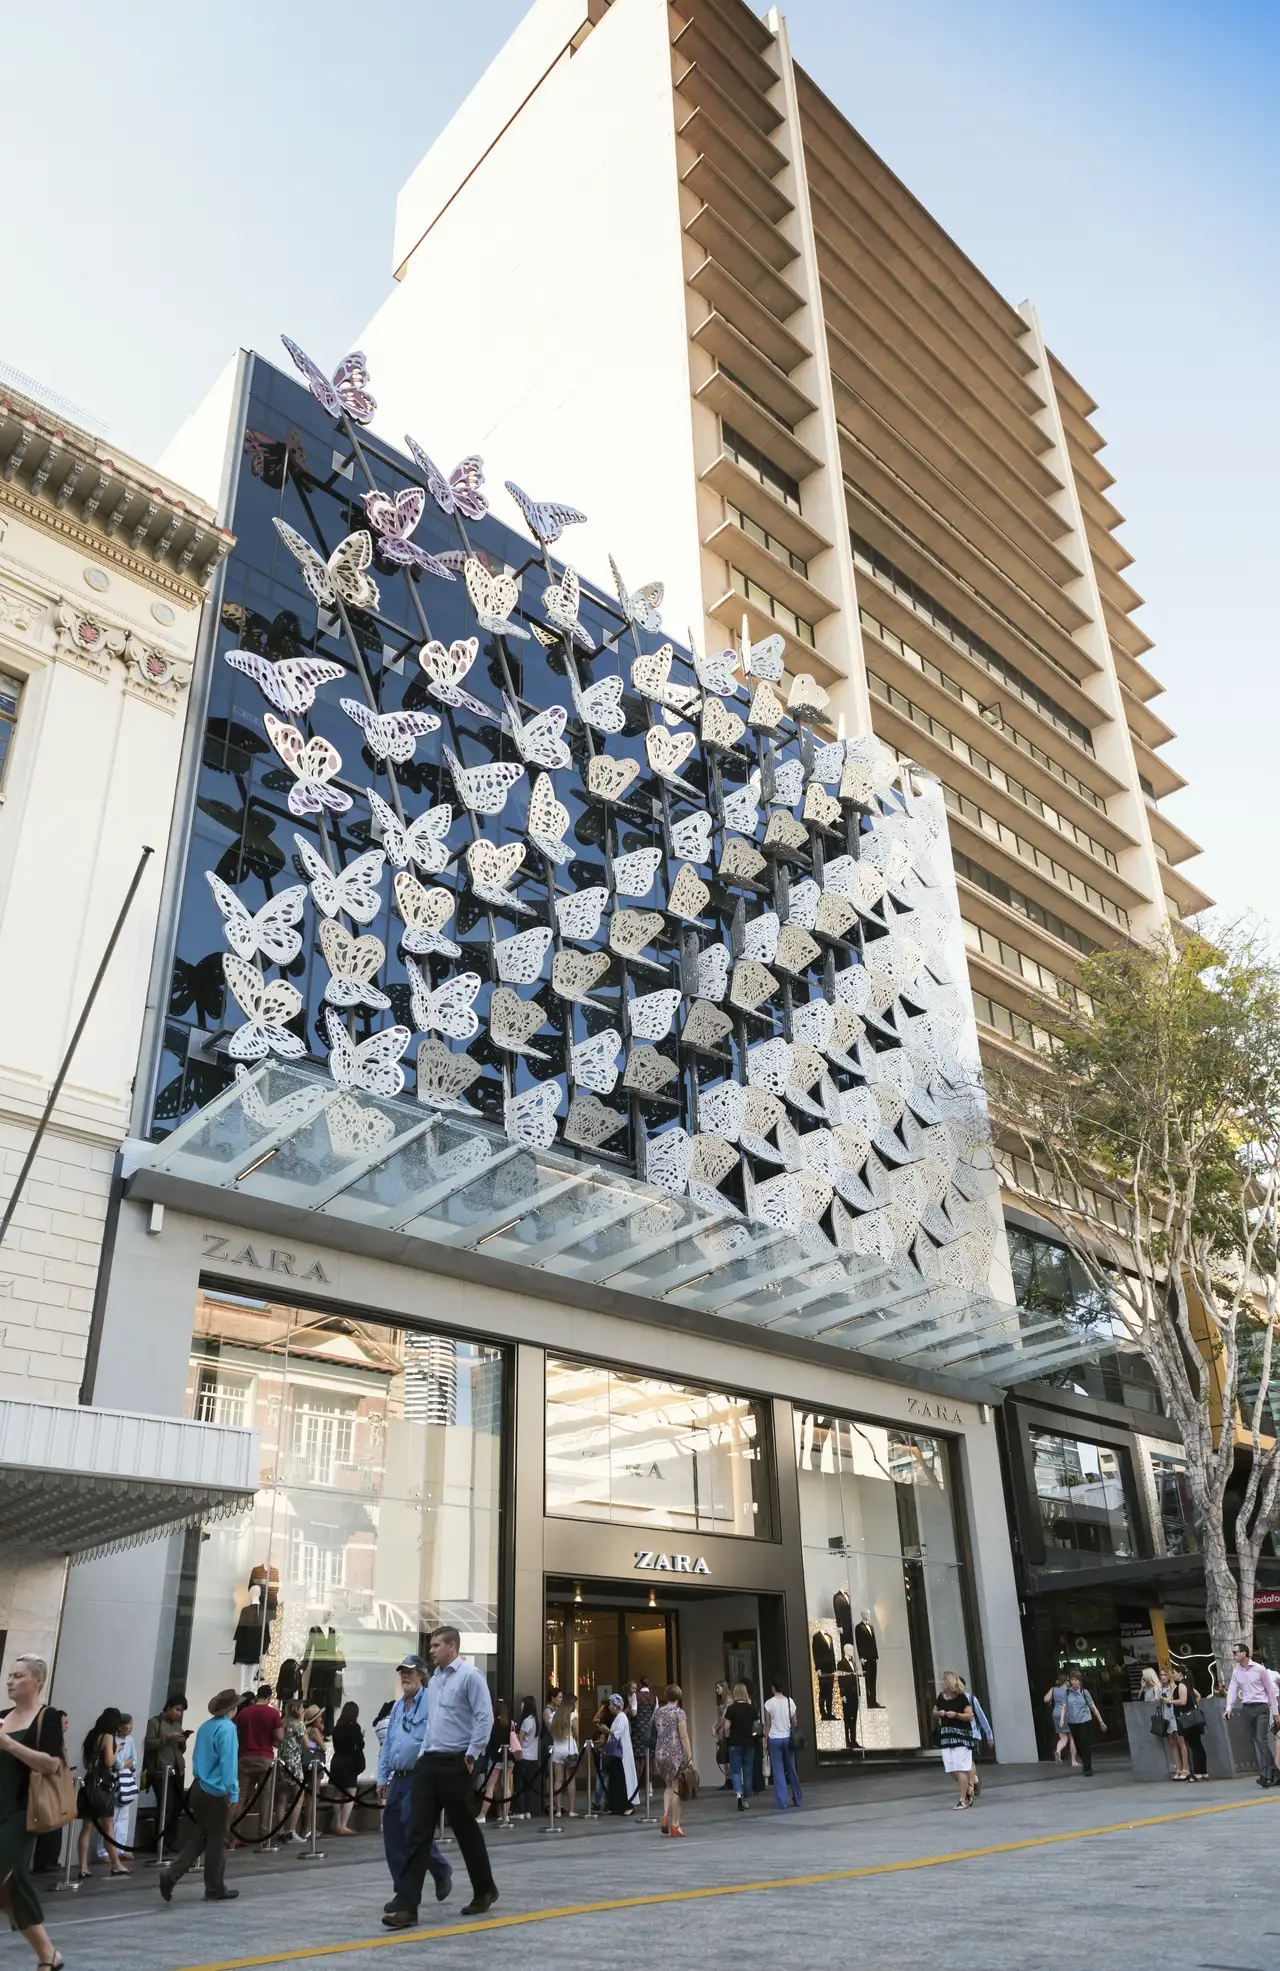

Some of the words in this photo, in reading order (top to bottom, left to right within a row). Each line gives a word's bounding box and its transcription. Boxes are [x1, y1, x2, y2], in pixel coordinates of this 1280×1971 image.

[201, 1233, 332, 1286] ZARA
[906, 1397, 964, 1424] ZARA
[634, 1551, 712, 1575] ZARA
